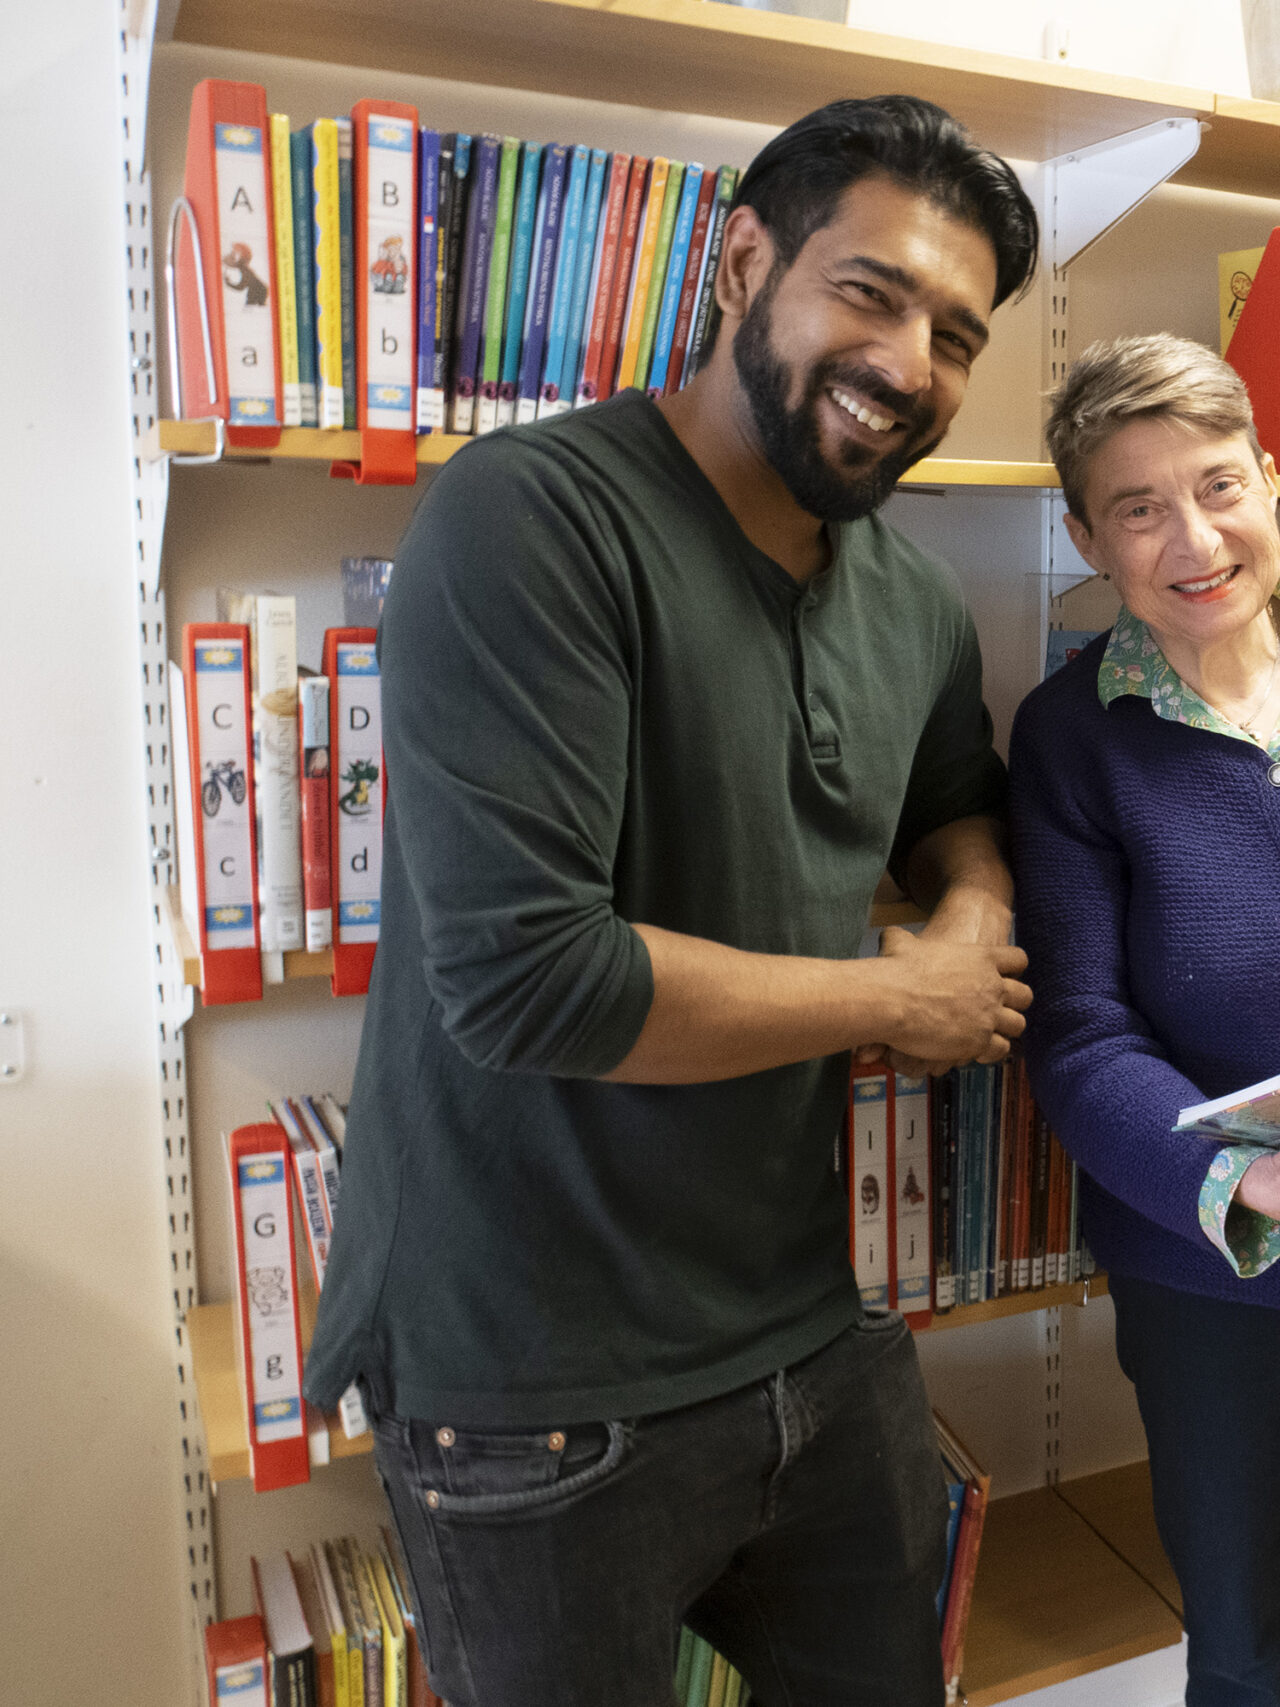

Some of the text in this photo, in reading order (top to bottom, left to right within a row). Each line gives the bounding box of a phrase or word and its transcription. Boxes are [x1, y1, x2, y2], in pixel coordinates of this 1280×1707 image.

[231, 187, 253, 213] A
[382, 181, 399, 207] B
[382, 328, 397, 354] b
[241, 346, 257, 366] a
[212, 703, 232, 731] C
[350, 706, 370, 730] D
[220, 856, 236, 876] c
[351, 847, 368, 872] d
[906, 1119, 914, 1140] J
[253, 1212, 276, 1239] G
[869, 1243, 873, 1264] i
[908, 1234, 914, 1260] j
[266, 1353, 284, 1381] g
